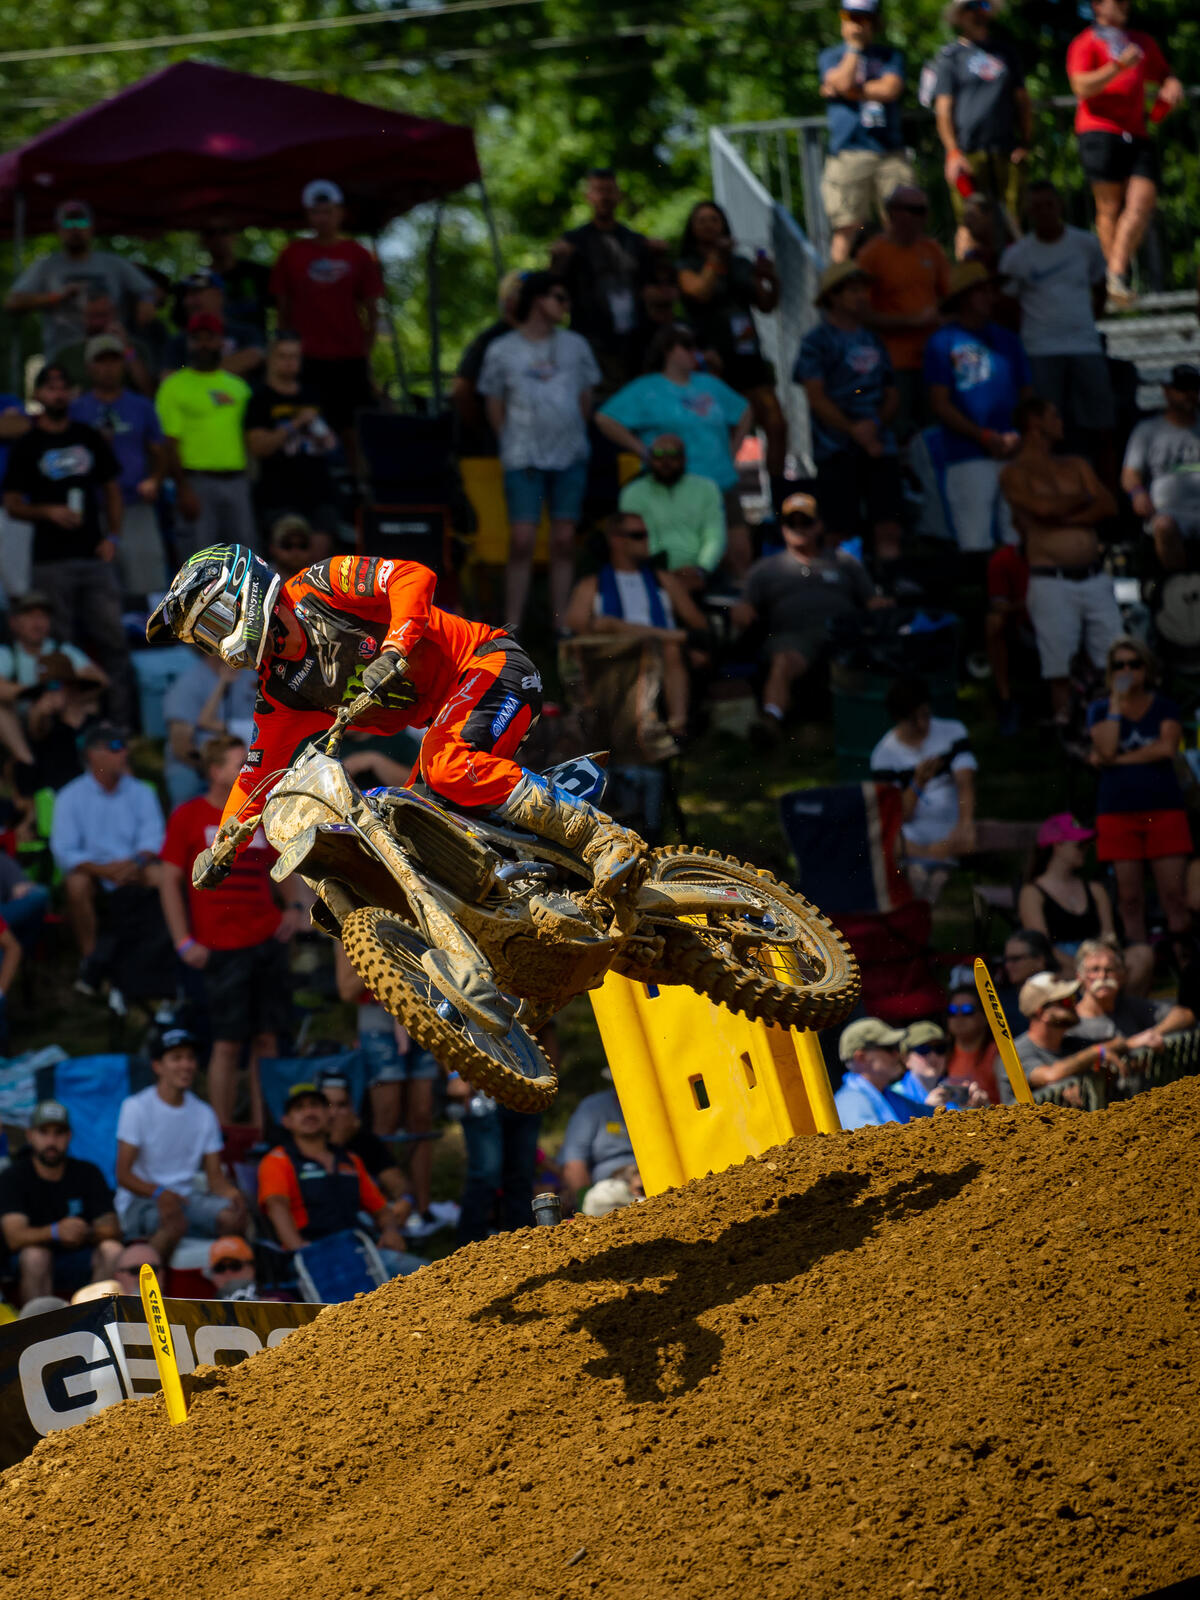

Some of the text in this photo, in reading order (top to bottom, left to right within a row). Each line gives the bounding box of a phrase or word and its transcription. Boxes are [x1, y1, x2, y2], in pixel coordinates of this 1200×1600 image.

[246, 581, 260, 626] MONSTER
[293, 658, 315, 687] YAMAHA
[499, 696, 520, 729] YAMAHA
[984, 980, 1011, 1040] ACERBIS
[149, 1289, 171, 1357] ACERBIS
